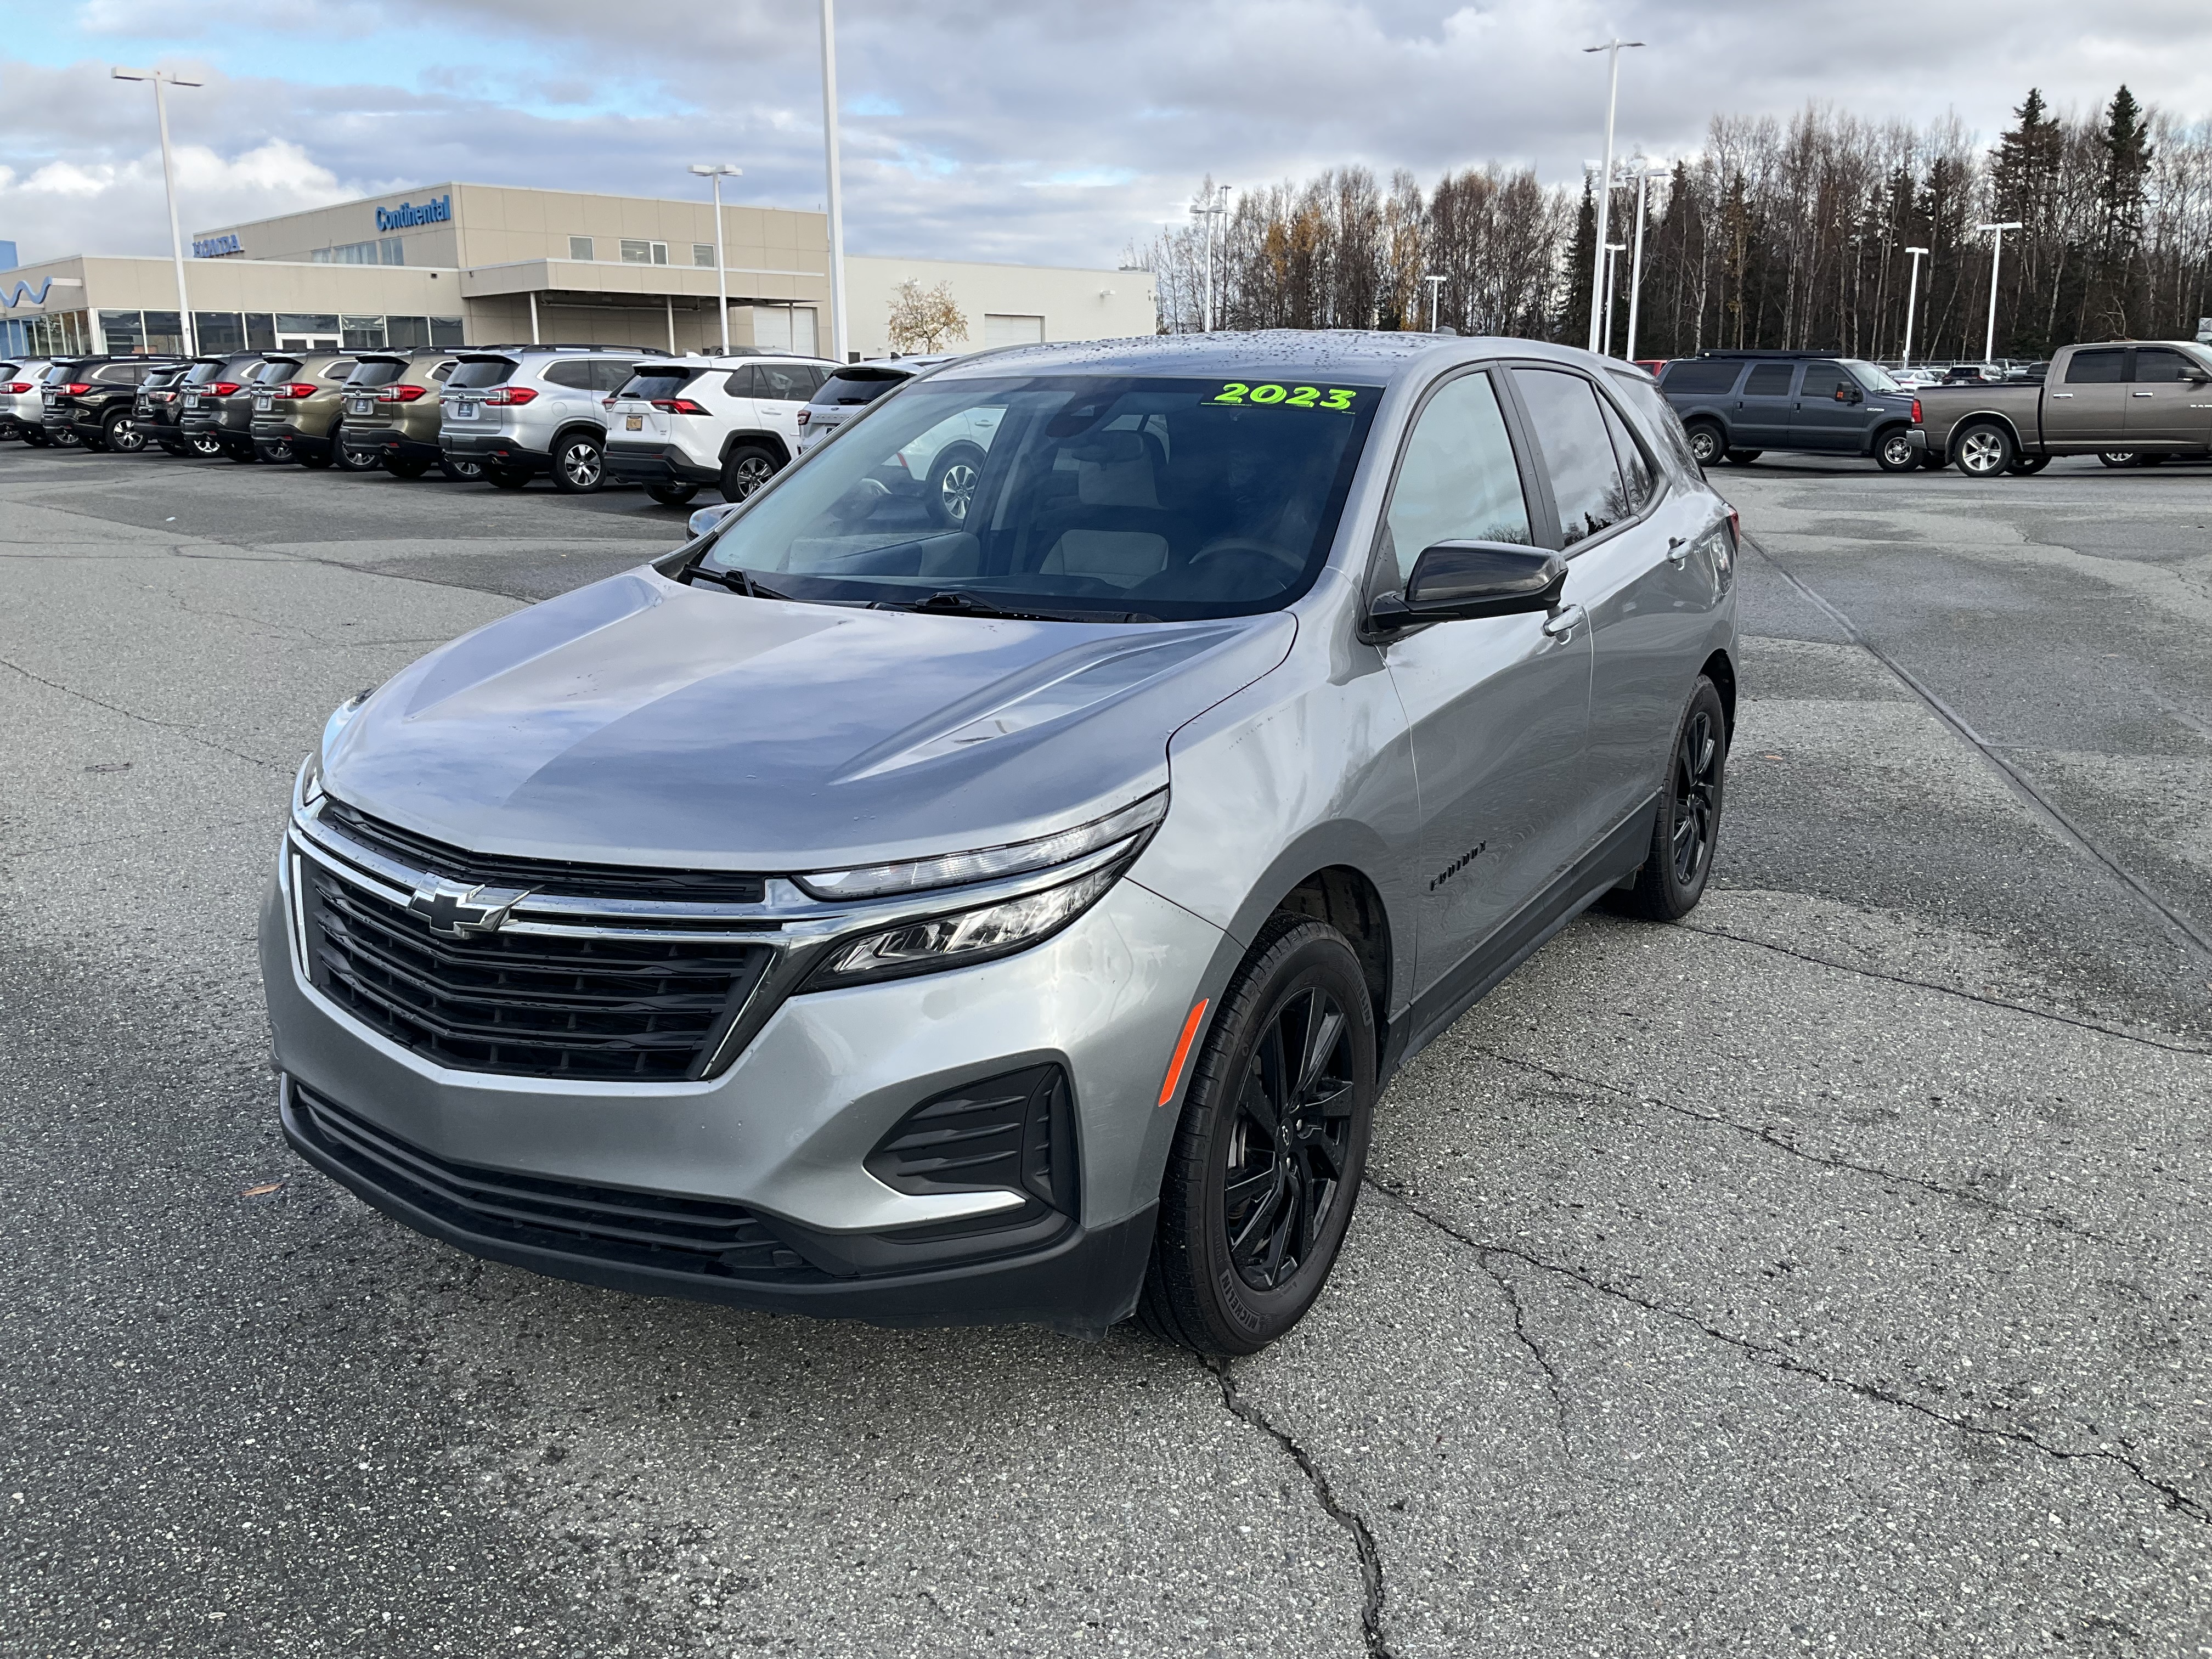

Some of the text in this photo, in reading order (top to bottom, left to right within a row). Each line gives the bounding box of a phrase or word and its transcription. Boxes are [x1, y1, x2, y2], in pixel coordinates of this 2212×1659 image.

[376, 195, 451, 232] Continental
[193, 235, 240, 258] HONDA
[1214, 383, 1357, 410] 2023
[1430, 840, 1486, 891] EQUINOX
[1222, 1274, 1259, 1330] MICHELIN
